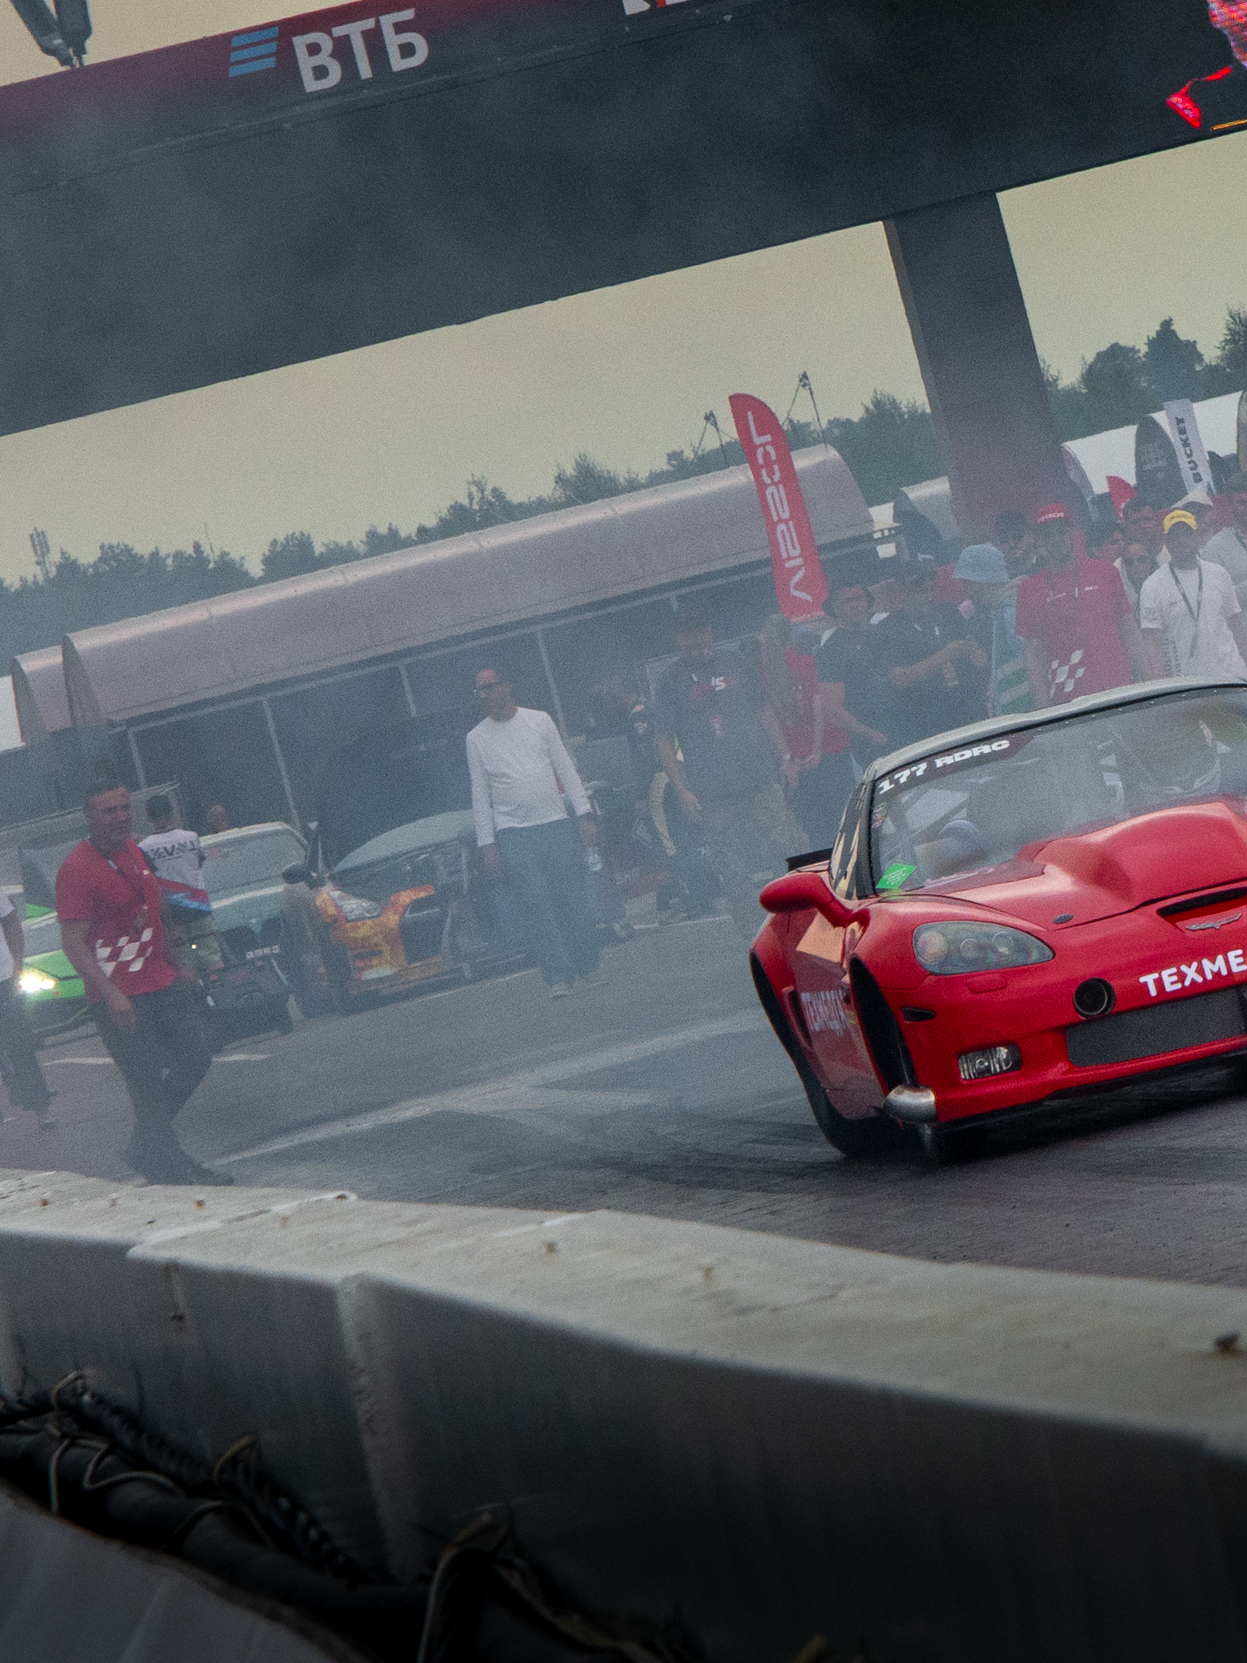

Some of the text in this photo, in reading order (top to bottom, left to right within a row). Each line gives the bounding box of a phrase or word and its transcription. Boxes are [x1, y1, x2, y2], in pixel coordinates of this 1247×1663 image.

[292, 8, 430, 93] ВТБ
[1174, 416, 1203, 484] BUCKET
[878, 739, 1010, 795] 177 RDRC
